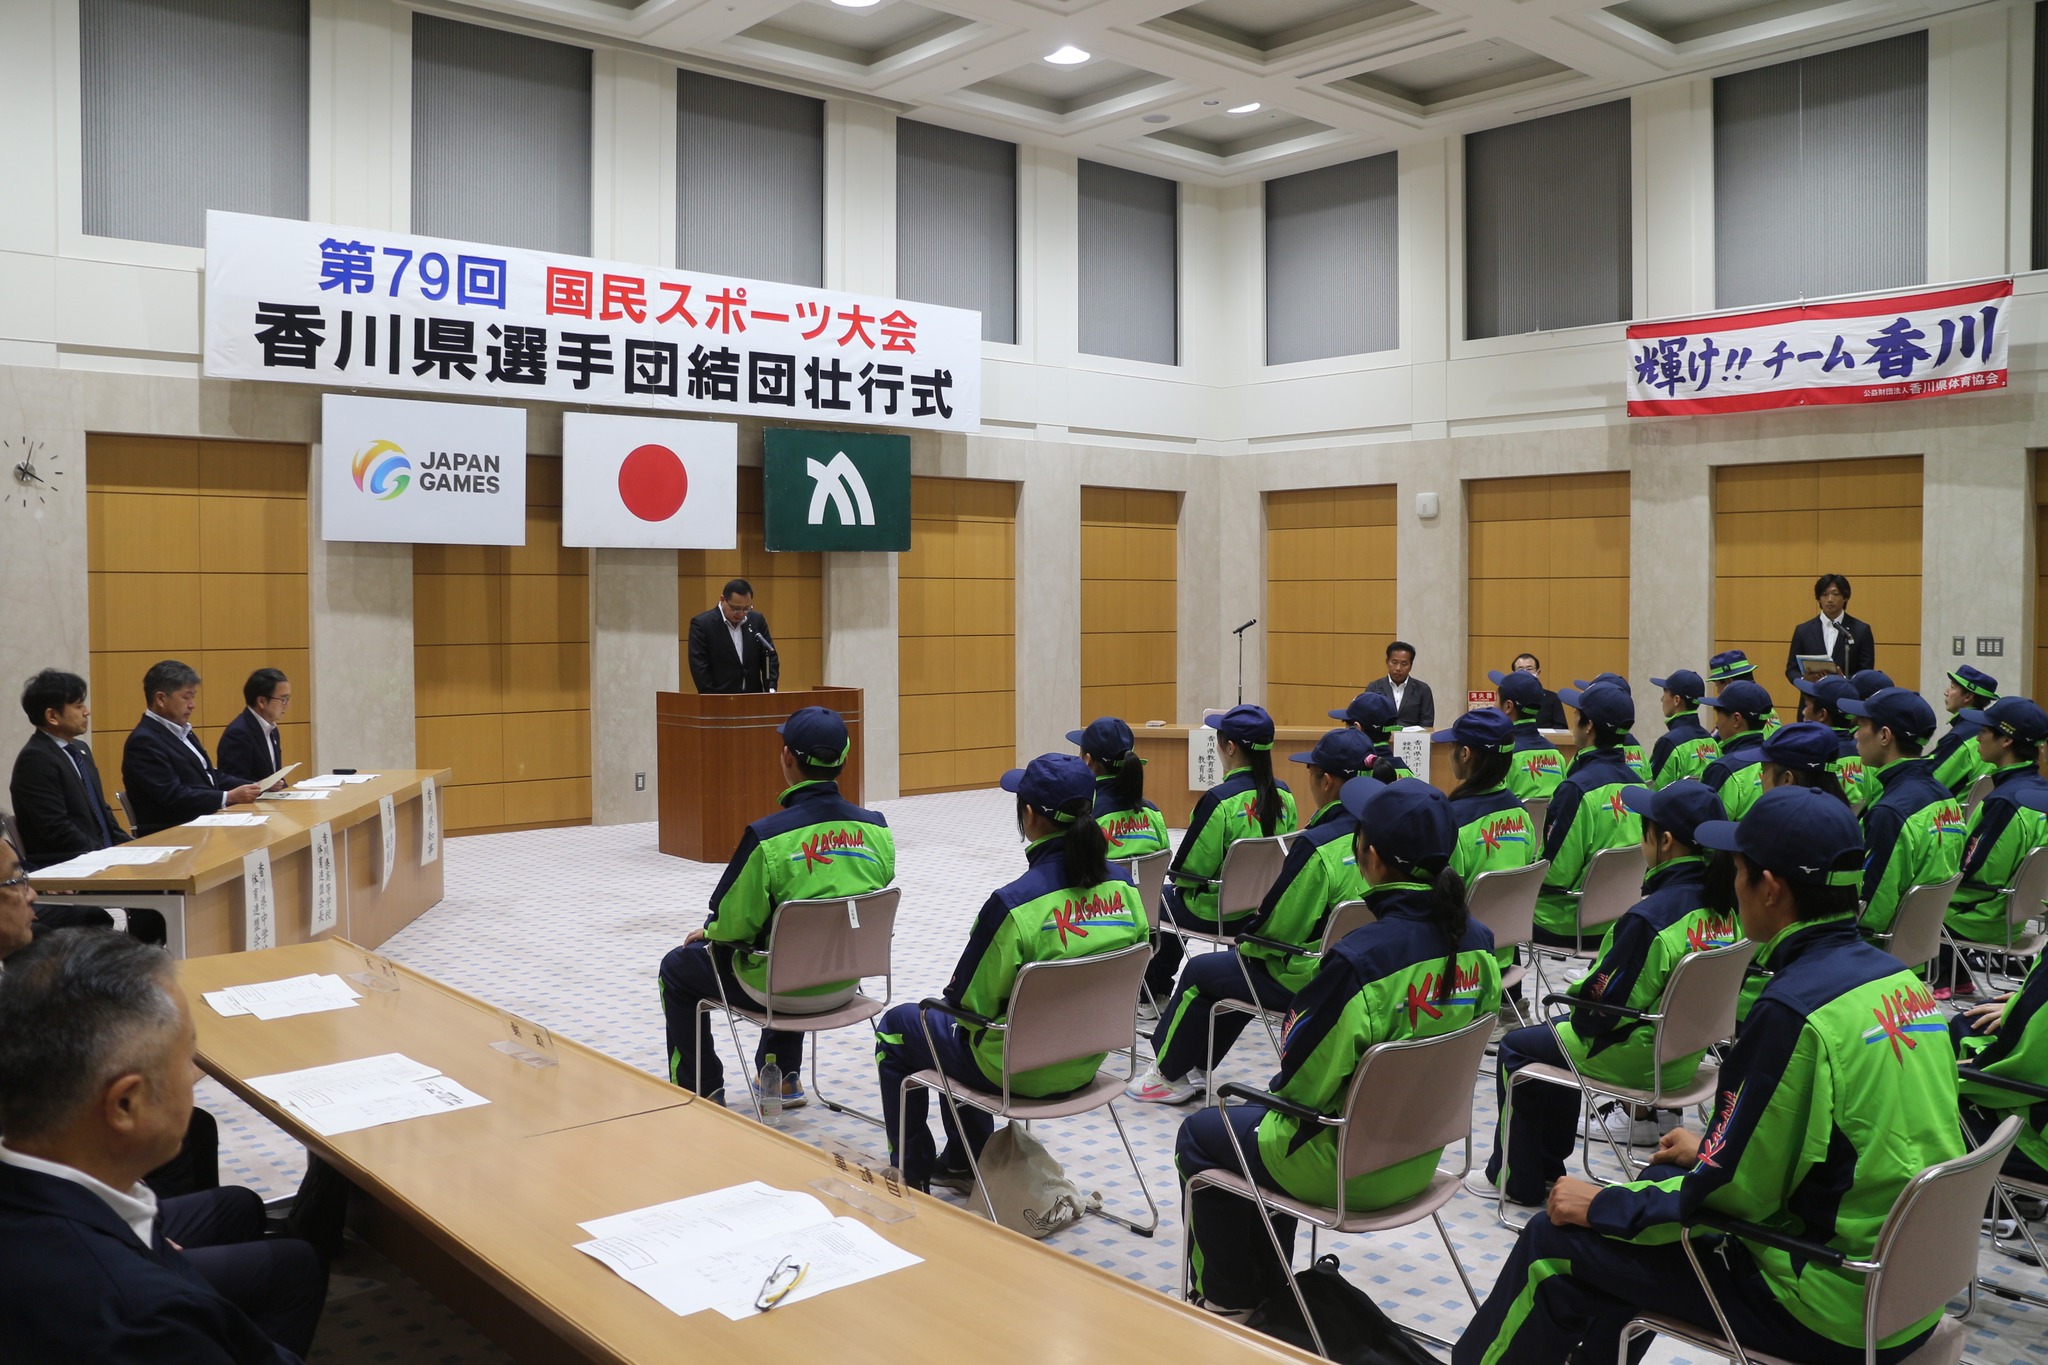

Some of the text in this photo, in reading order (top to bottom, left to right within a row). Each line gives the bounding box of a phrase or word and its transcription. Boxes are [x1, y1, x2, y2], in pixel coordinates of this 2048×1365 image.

[319, 238, 918, 354] 第79回 国民スポーツ大会
[254, 302, 954, 420] 香川県選手団結団壮行式
[1910, 373, 1998, 394] 香川県体育協会
[419, 473, 500, 495] GAMES
[420, 451, 500, 476] JAPAN
[1198, 755, 1206, 783] 教育長
[802, 828, 864, 876] KAGAWA
[1481, 815, 1523, 857] KAGAWA
[1053, 891, 1125, 951] KAGAWA
[1408, 961, 1479, 1029] KAAWA
[1873, 985, 1937, 1069] KAGAWA
[1697, 1090, 1737, 1168] KAGAWA
